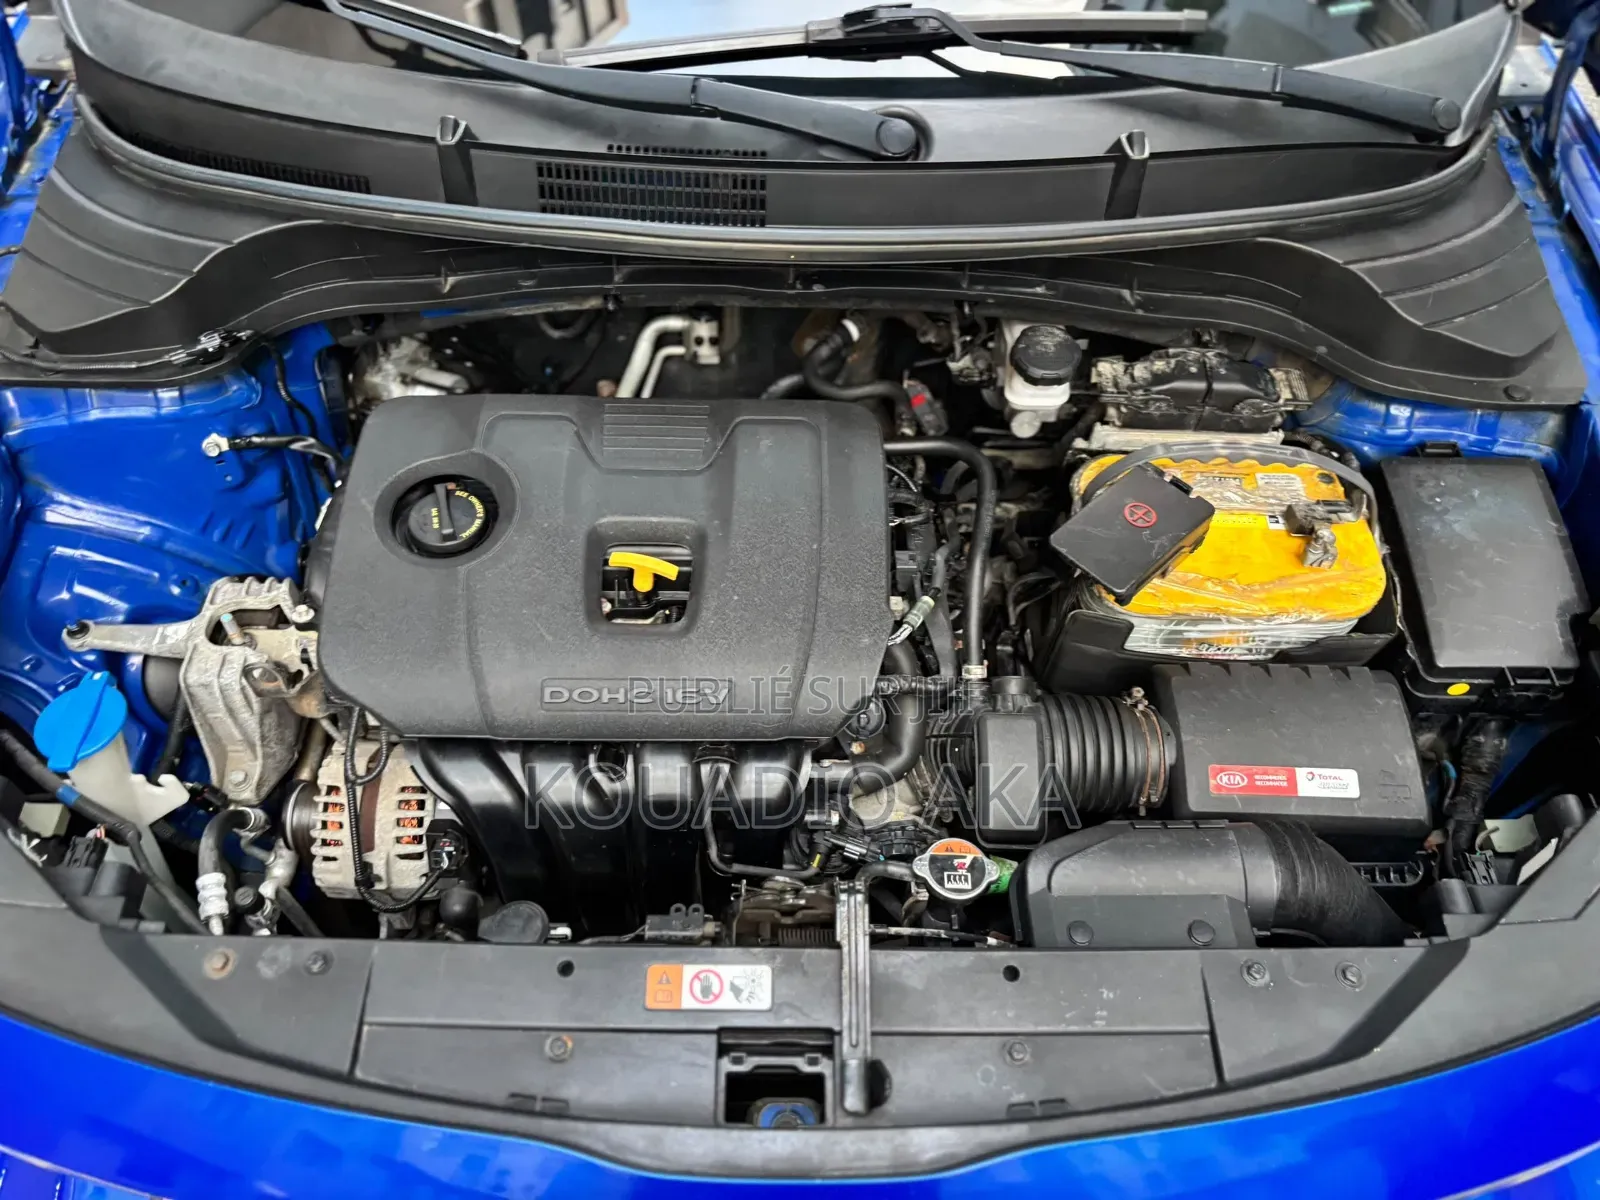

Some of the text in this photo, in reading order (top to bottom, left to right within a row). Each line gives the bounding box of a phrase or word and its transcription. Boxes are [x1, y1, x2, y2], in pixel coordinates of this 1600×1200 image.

[543, 686, 730, 704] DOHC 16V
[1317, 773, 1344, 781] TOTAL
